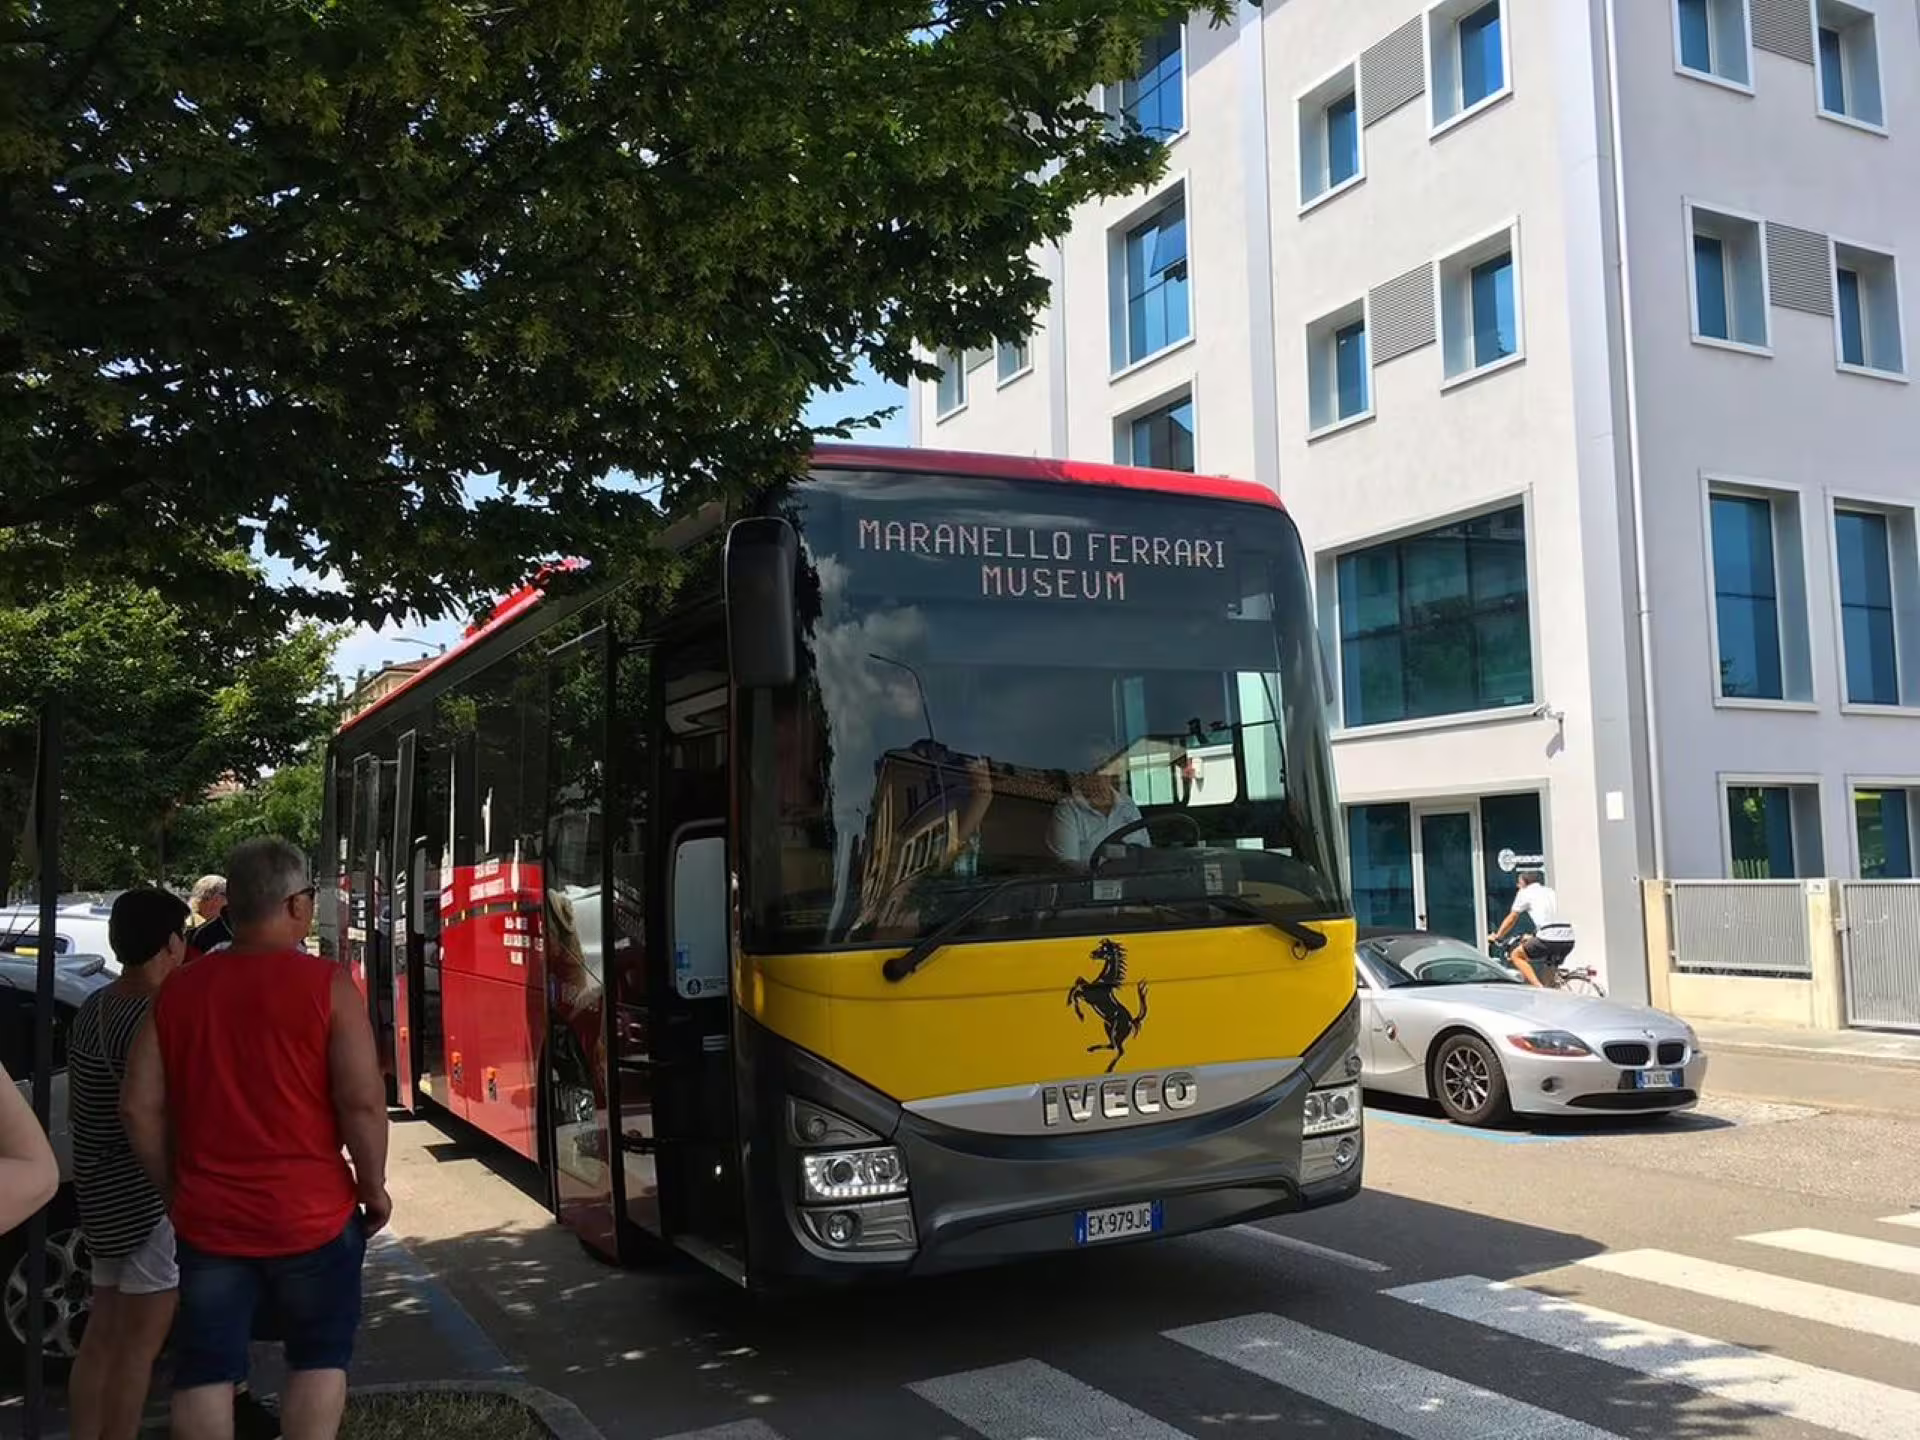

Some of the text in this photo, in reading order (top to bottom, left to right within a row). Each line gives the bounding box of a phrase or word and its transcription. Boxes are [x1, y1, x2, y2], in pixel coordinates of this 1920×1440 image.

[859, 518, 1225, 569] MARANELLO FERRARI
[982, 564, 1126, 601] MUSEUM
[1043, 1072, 1198, 1127] IVECO
